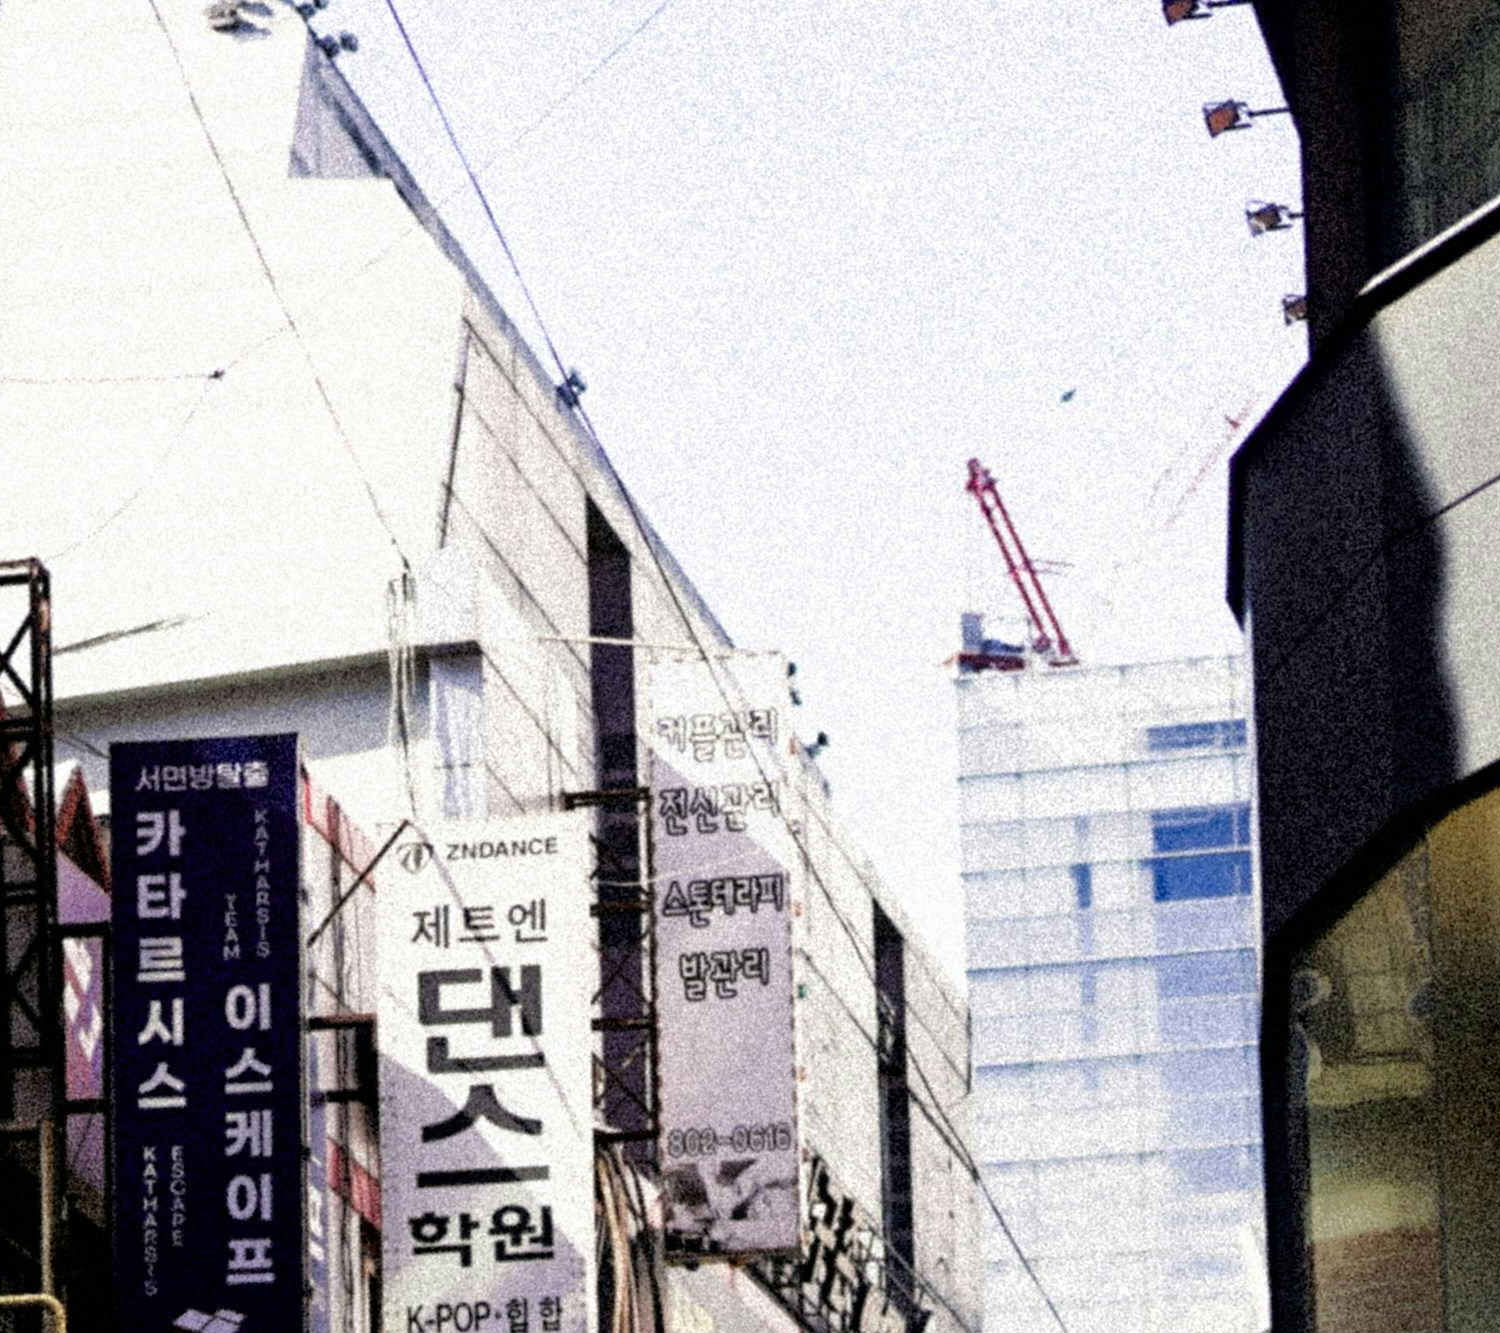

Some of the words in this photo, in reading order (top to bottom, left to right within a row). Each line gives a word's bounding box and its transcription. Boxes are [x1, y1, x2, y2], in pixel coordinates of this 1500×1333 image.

[135, 761, 268, 792] 서면방탈출
[660, 781, 780, 835] 전신관리
[447, 837, 558, 862] ZNDANCE
[223, 894, 240, 960] TEAM
[410, 898, 548, 949] 제트엔
[662, 874, 784, 928] 스톤테라피
[136, 809, 187, 1108] 카타르시스
[679, 948, 769, 1001] 발관리
[417, 964, 548, 1187] 댄스
[225, 983, 275, 1284] 이스케이프
[408, 1205, 554, 1267] 학원
